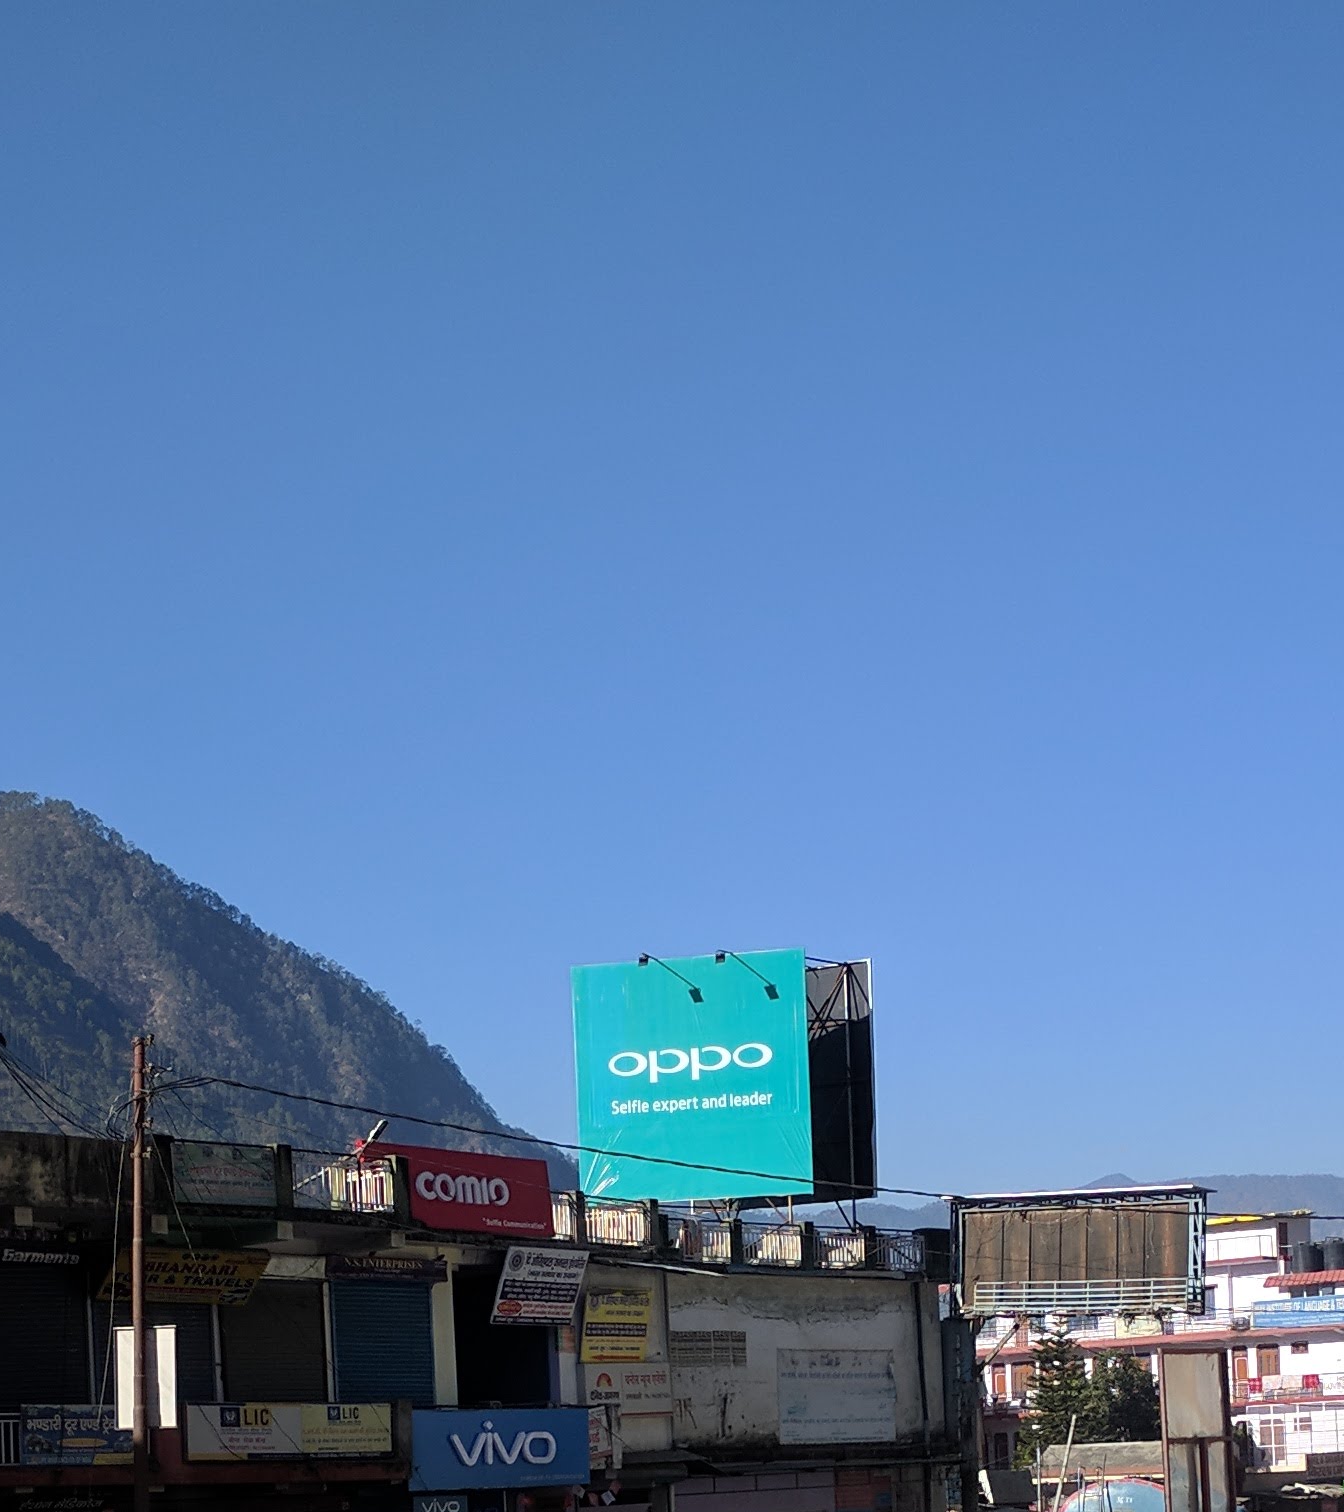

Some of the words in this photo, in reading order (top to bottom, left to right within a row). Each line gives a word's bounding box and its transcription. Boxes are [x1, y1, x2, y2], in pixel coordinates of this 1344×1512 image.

[610, 1098, 650, 1115] Selfie
[652, 1097, 698, 1115] expert
[701, 1094, 727, 1110] and
[729, 1089, 773, 1108] leader
[243, 1408, 269, 1425] LIC
[342, 1406, 359, 1420] LIC
[449, 1419, 557, 1467] vivo
